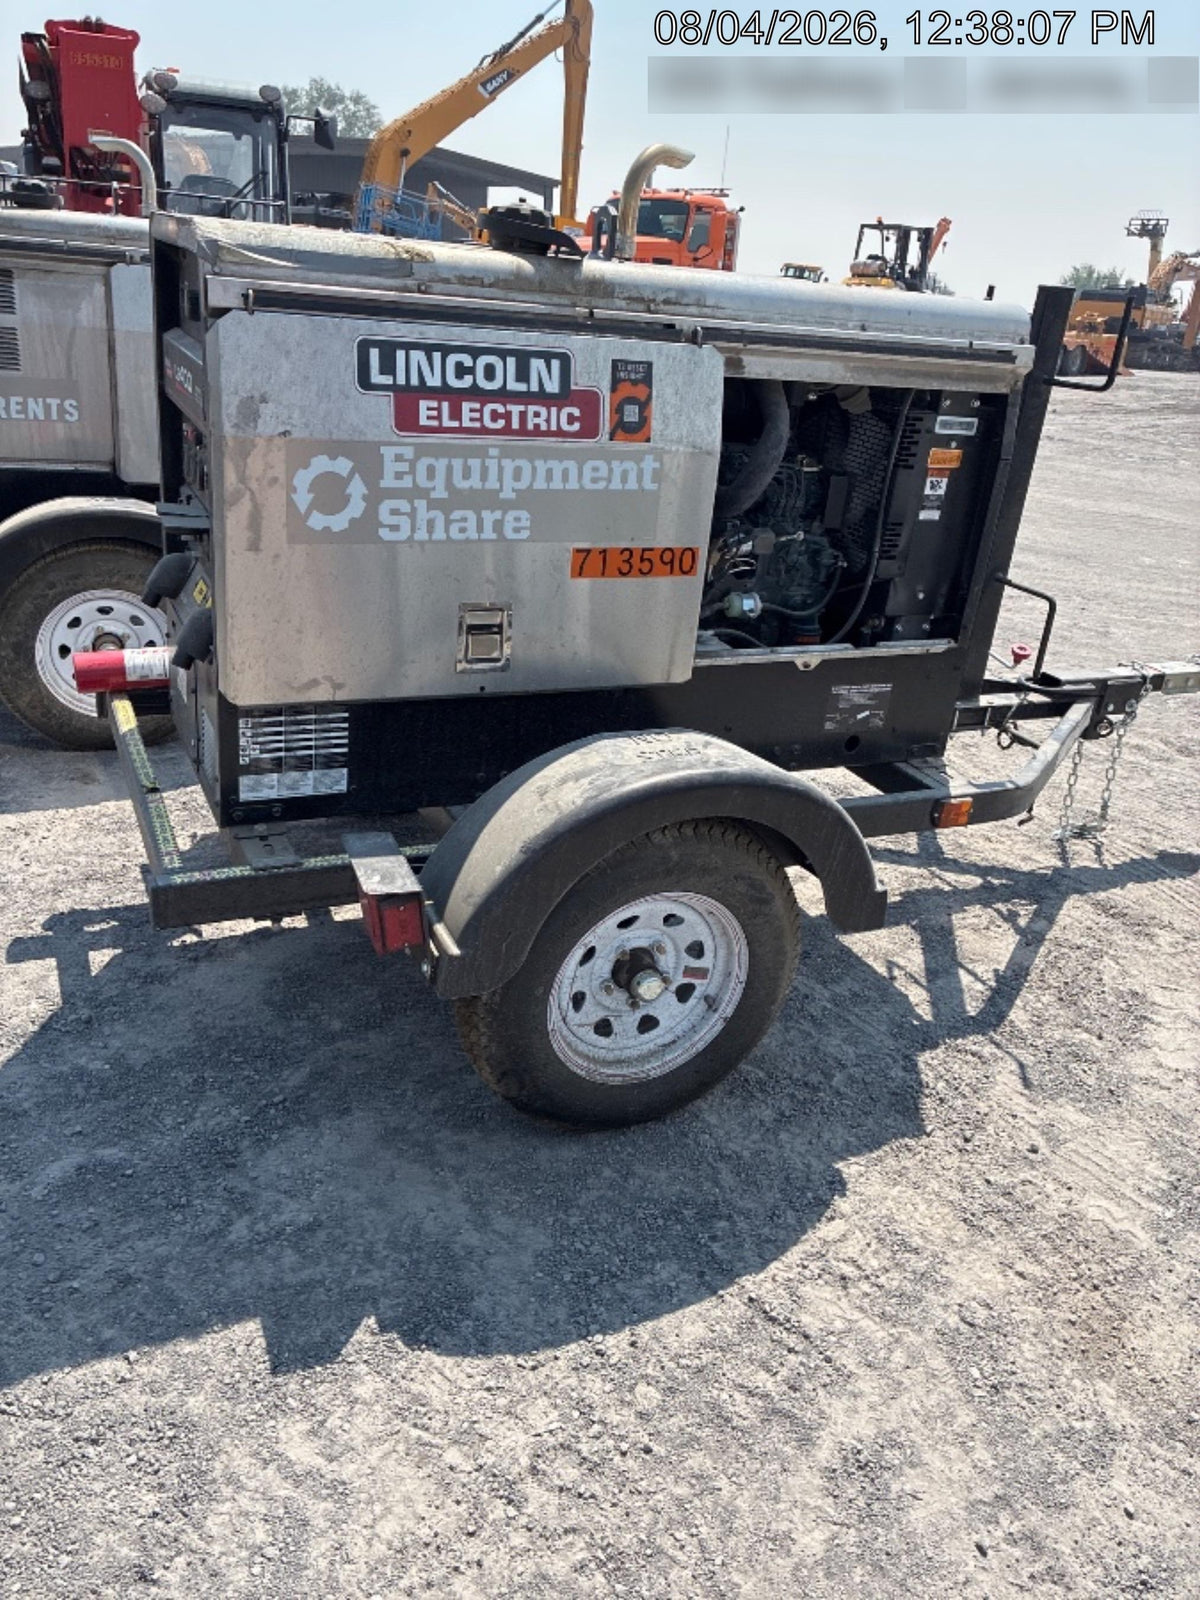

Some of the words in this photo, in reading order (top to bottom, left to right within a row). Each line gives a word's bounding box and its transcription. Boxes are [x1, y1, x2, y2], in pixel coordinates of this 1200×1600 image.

[369, 347, 561, 395] LINCOLN
[418, 399, 582, 432] ELECTRIC
[379, 445, 661, 499] Equipment
[377, 498, 532, 542] Share
[574, 547, 698, 578] 713590
